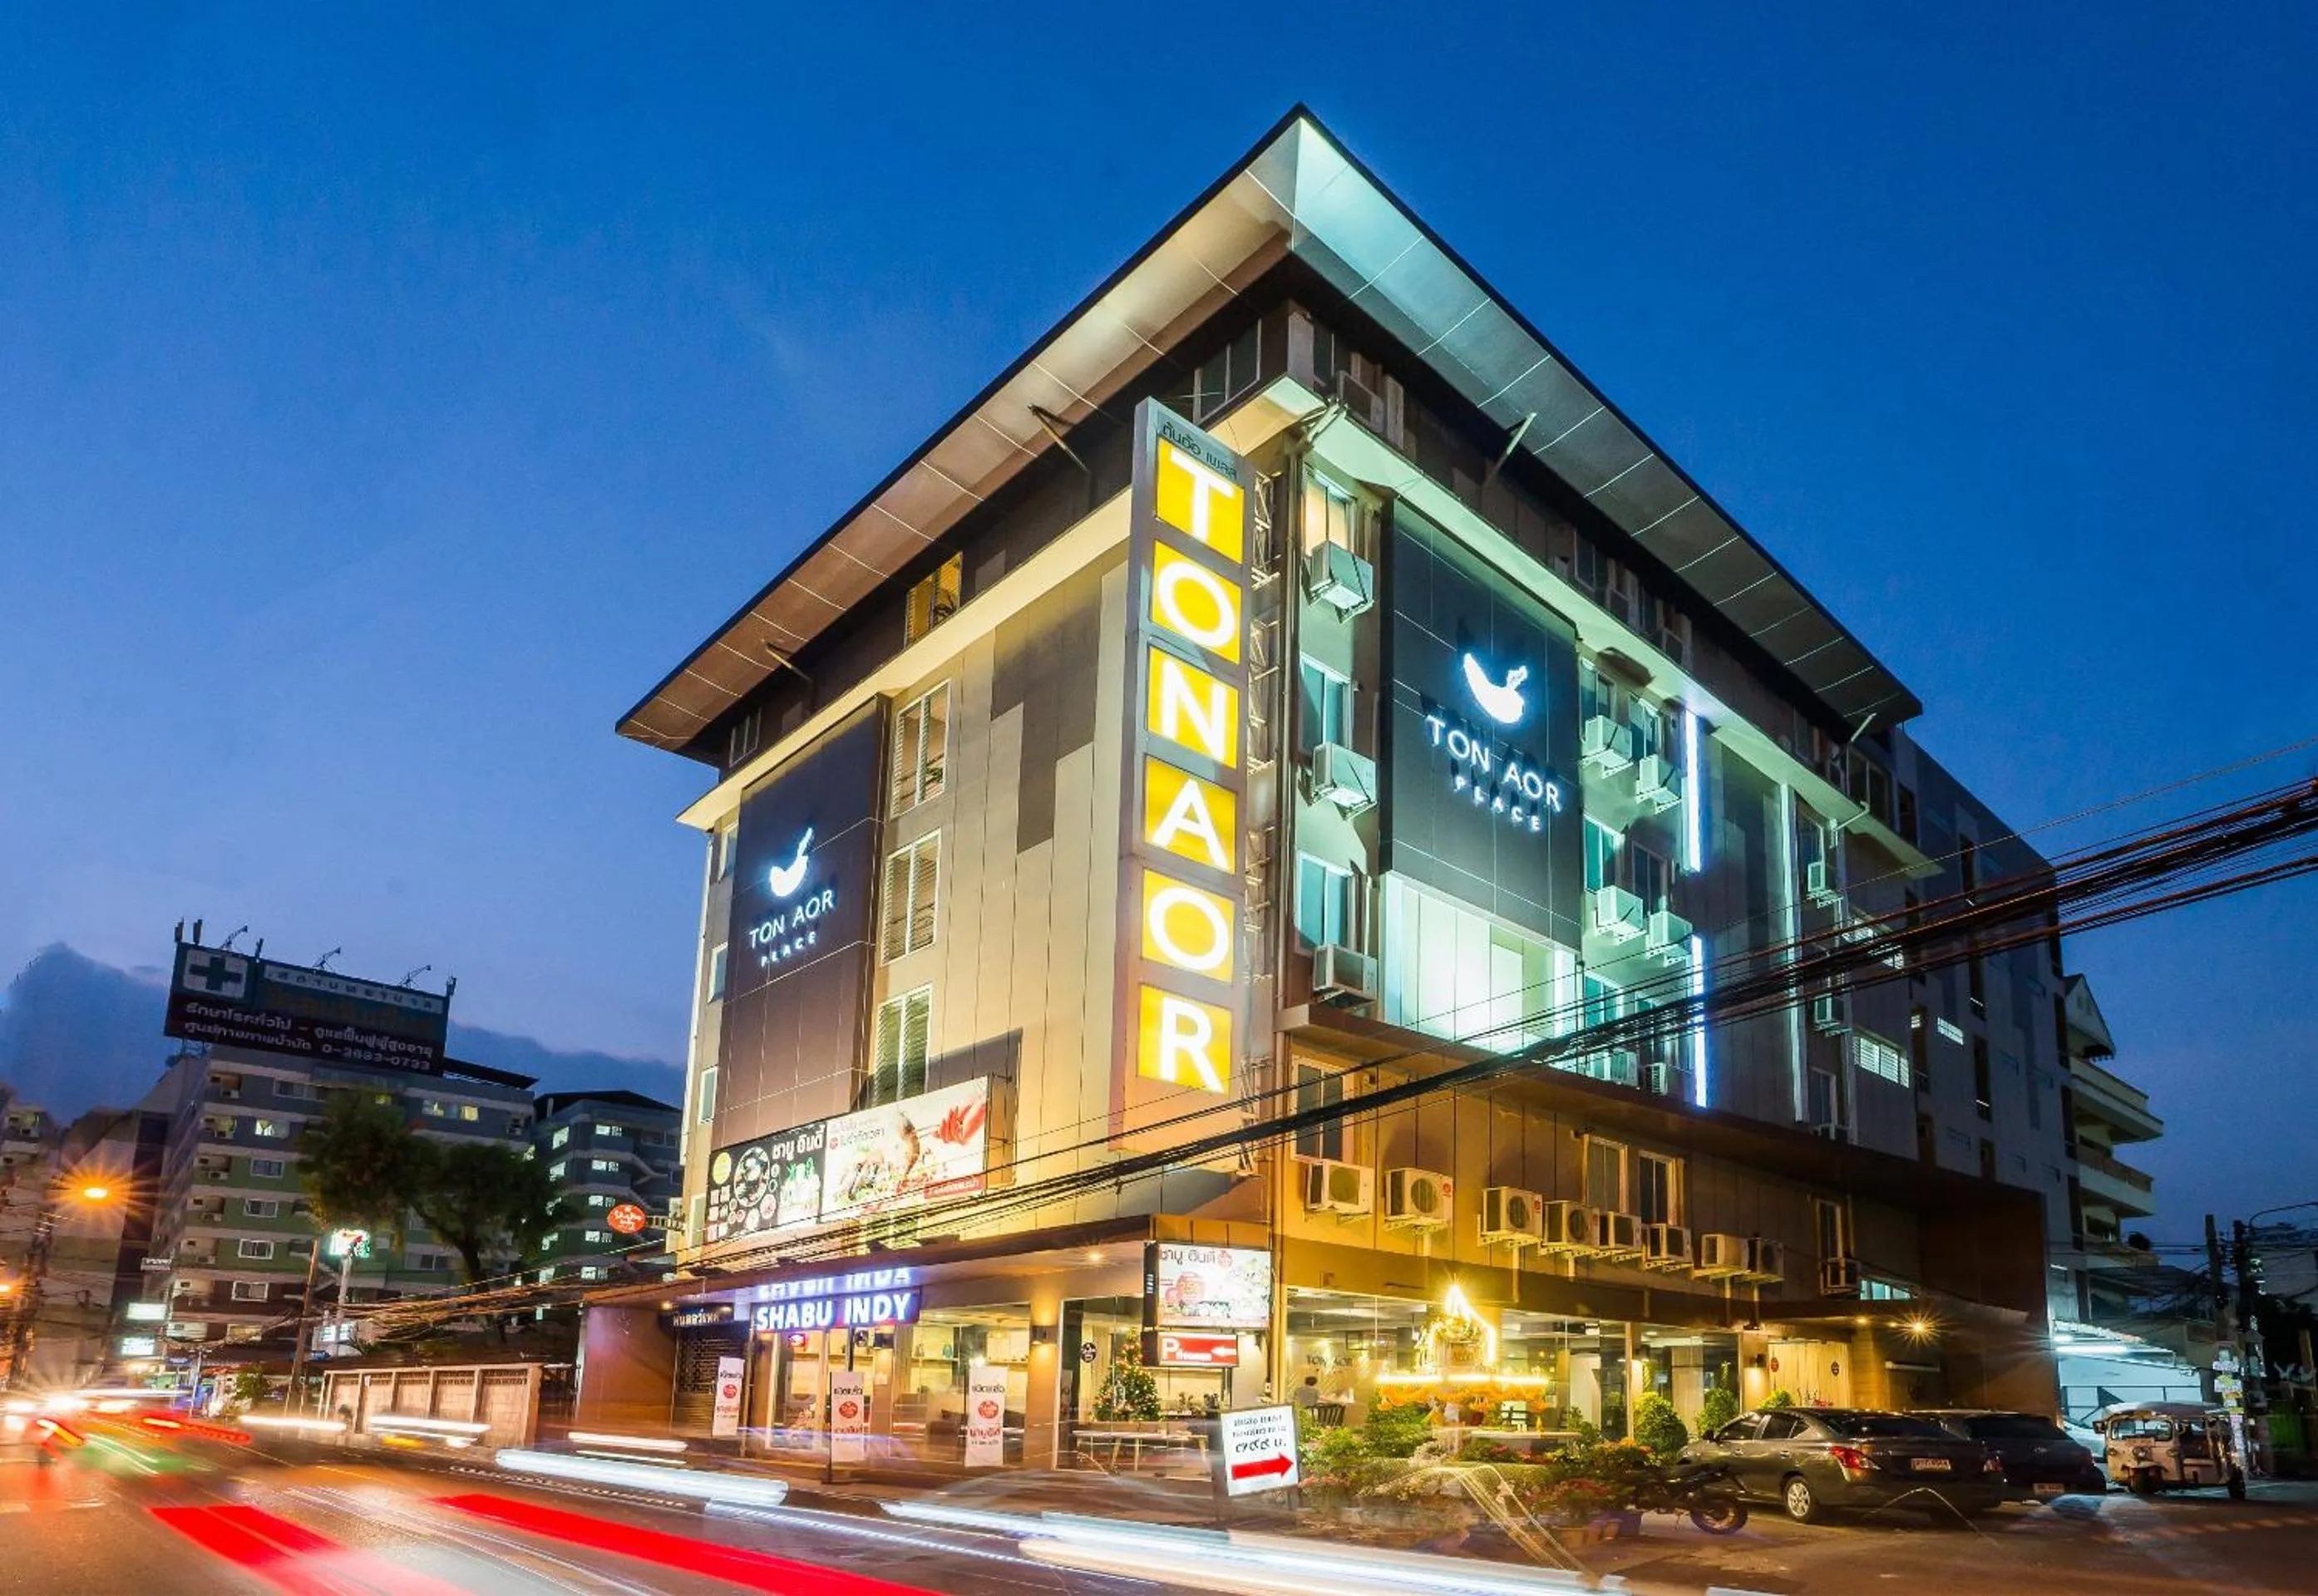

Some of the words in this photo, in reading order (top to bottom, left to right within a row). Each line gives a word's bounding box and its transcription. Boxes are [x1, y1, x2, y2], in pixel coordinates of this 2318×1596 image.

[1424, 713, 1490, 773] TON
[1503, 761, 1561, 813] AOR
[1454, 775, 1541, 832] PLACE
[748, 914, 785, 949] TON
[792, 889, 836, 929] AOR
[760, 930, 816, 968] PLACE
[772, 1140, 794, 1160] ชาบู
[755, 1300, 832, 1331] SHABU
[843, 1292, 912, 1326] INDY
[1162, 1337, 1179, 1361] P
